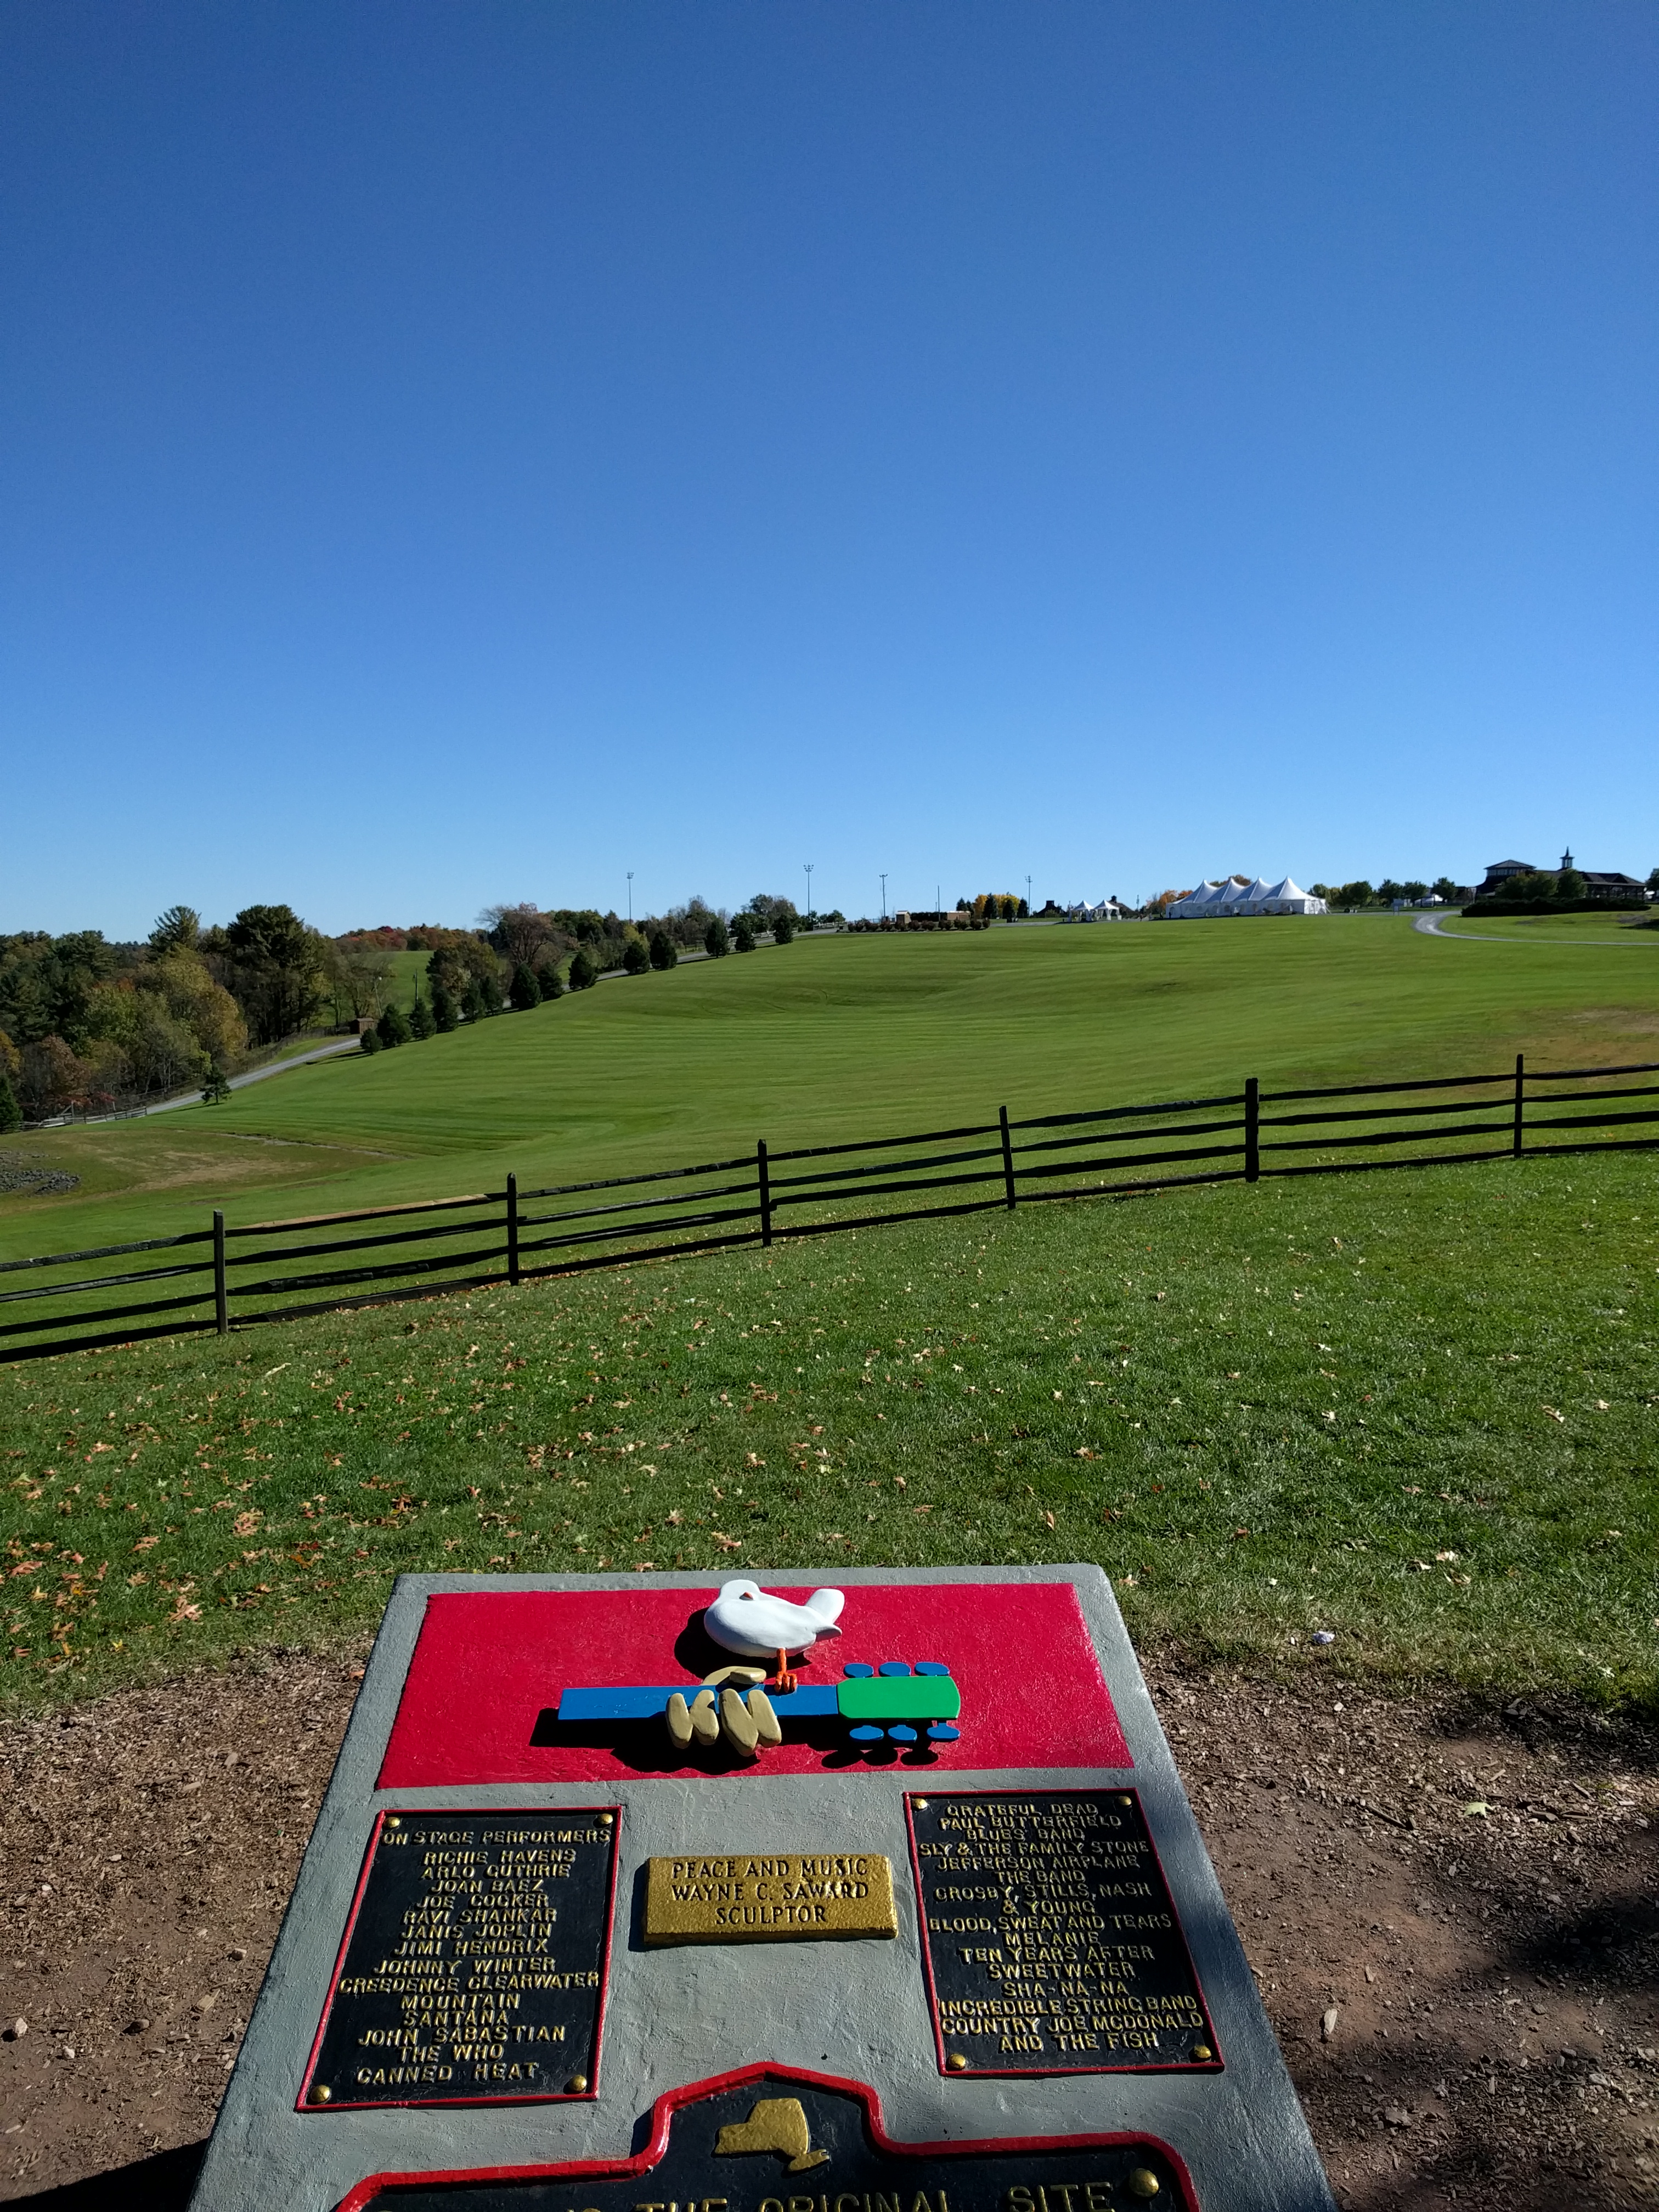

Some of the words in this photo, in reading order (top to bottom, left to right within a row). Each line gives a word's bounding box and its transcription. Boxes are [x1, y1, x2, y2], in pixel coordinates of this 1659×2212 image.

[947, 1804, 1042, 1818] GRATEFUL
[1051, 1803, 1098, 1815] DEAD
[939, 1817, 985, 1831] PAUL
[991, 1815, 1121, 1829] BUTTERFIELD
[383, 1832, 408, 1845] ON
[413, 1831, 474, 1845] STAGE
[481, 1830, 611, 1844] PERFORMERS
[967, 1829, 1025, 1842] BLUES
[1038, 1828, 1085, 1841] BAND
[424, 1850, 488, 1865] RICHIE
[501, 1848, 577, 1864] HAVENS
[919, 1843, 953, 1857] SLY
[957, 1842, 973, 1857] &
[975, 1843, 1011, 1857] THE
[1018, 1842, 1084, 1856] FAMILY
[1091, 1841, 1149, 1854] STONE
[673, 1860, 736, 1879] PEACE
[744, 1860, 788, 1877] AND
[802, 1858, 868, 1877] MUSIC
[938, 1857, 1045, 1871] JEFFERSON
[1052, 1855, 1140, 1869] AIRPLANE
[420, 1866, 476, 1880] ARLO
[487, 1864, 571, 1878] GUTHRIE
[994, 1871, 1031, 1884] THE
[1036, 1870, 1086, 1884] BAND
[431, 1880, 483, 1893] JOAN
[492, 1879, 544, 1893] BAEZ
[672, 1883, 743, 1902] WAYNE
[756, 1883, 772, 1901] C.
[783, 1881, 868, 1899] SAWARD
[935, 1886, 1019, 1903] CROSBY,
[1099, 1882, 1152, 1898] NASH
[416, 1895, 456, 1910] JOE
[470, 1893, 549, 1908] COCKER
[1002, 1899, 1019, 1916] &
[1024, 1900, 1096, 1915] YOUNG
[403, 1910, 450, 1925] RAVI
[459, 1908, 557, 1924] SHANKAR
[715, 1905, 826, 1925] SCULPTOR
[998, 1916, 1062, 1932] SWEAT
[1068, 1915, 1105, 1930] AND
[1109, 1914, 1171, 1930] TEARS
[400, 1925, 465, 1939] JANIS
[475, 1923, 552, 1939] JOPLIN
[394, 1940, 442, 1956] JIMI
[455, 1939, 548, 1955] HENDRIX
[1005, 1932, 1101, 1948] MELANIE
[960, 1948, 1002, 1964] TEN
[1008, 1946, 1077, 1962] YEARS
[1087, 1945, 1155, 1961] AFTER
[373, 1960, 462, 1975] JOHNNY
[474, 1957, 556, 1972] WINTER
[989, 1962, 1136, 1980] SWEETWATER
[338, 1977, 460, 1994] CREEDENCE
[467, 1971, 599, 1990] CLEARWATER
[400, 1994, 520, 2010] MOUNTAIN
[940, 2000, 1062, 2017] INCREDIBLE
[1067, 1996, 1142, 2015] STRING
[1146, 1995, 1197, 2012] BAND
[403, 2010, 508, 2027] SANTANA
[941, 2017, 1040, 2034] COUNTRY
[1048, 2016, 1088, 2033] JOE
[1092, 2012, 1203, 2032] MCDONALD
[358, 2029, 419, 2046] JOHN
[433, 2025, 565, 2044] SABASTIAN
[1001, 2035, 1043, 2052] AND
[1054, 2033, 1099, 2051] THE
[1107, 2032, 1159, 2050] FISH
[398, 2045, 441, 2063] THE
[453, 2044, 504, 2061] WHO
[357, 2065, 453, 2084] CANNED
[475, 2062, 539, 2081] HEAT
[1008, 2182, 1115, 2212] SITE
